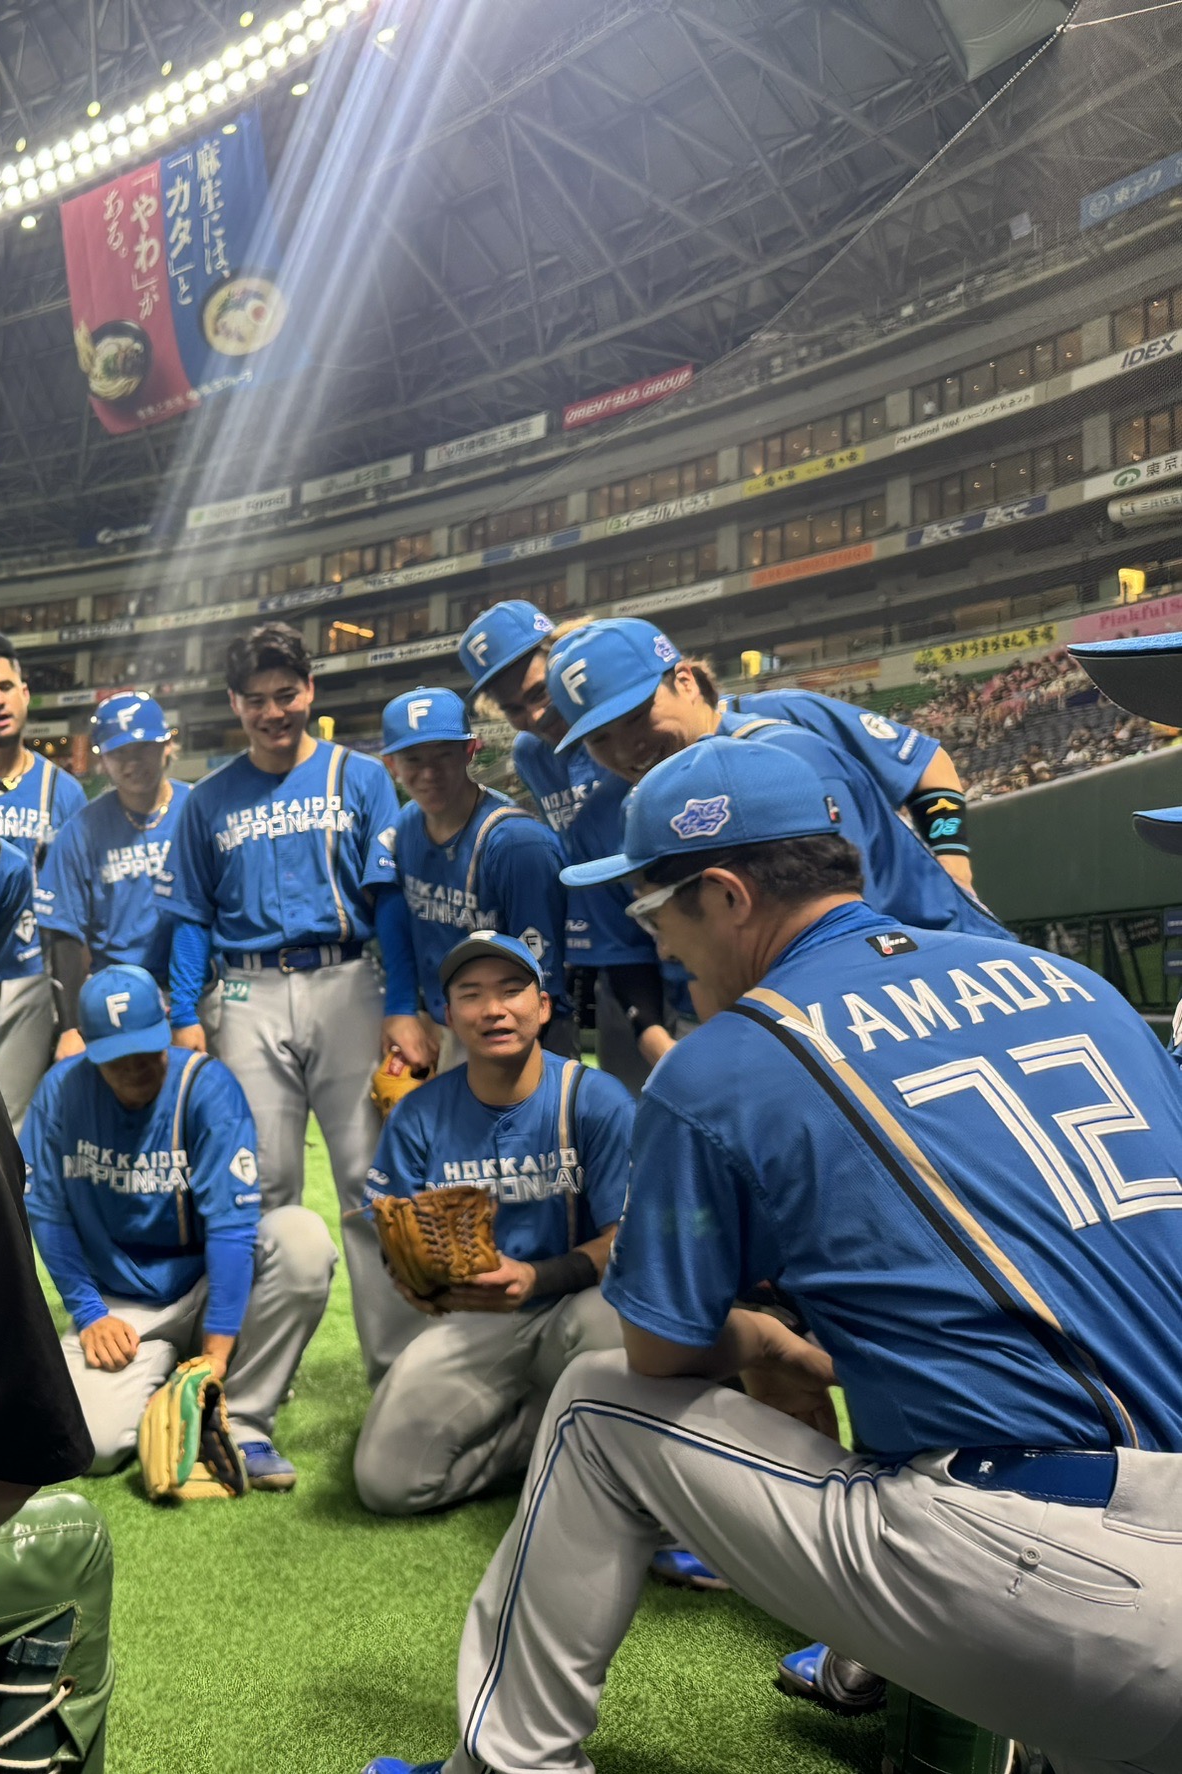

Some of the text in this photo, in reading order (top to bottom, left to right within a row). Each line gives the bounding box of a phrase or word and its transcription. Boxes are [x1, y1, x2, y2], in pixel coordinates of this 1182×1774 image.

[1120, 332, 1178, 370] IDEX
[1146, 453, 1182, 478] 東京
[468, 632, 489, 667] F
[561, 658, 588, 706] F
[117, 702, 141, 731] F
[407, 699, 433, 730] F
[226, 795, 342, 830] HOKKAIDO
[215, 808, 355, 853] NIPPONHAM
[106, 992, 131, 1028] F
[777, 956, 1096, 1063] YAMADA
[893, 1034, 1182, 1230] 72
[76, 1139, 188, 1169] HOKKAIDO
[238, 1160, 251, 1177] F
[62, 1154, 193, 1195] NIPPONHA
